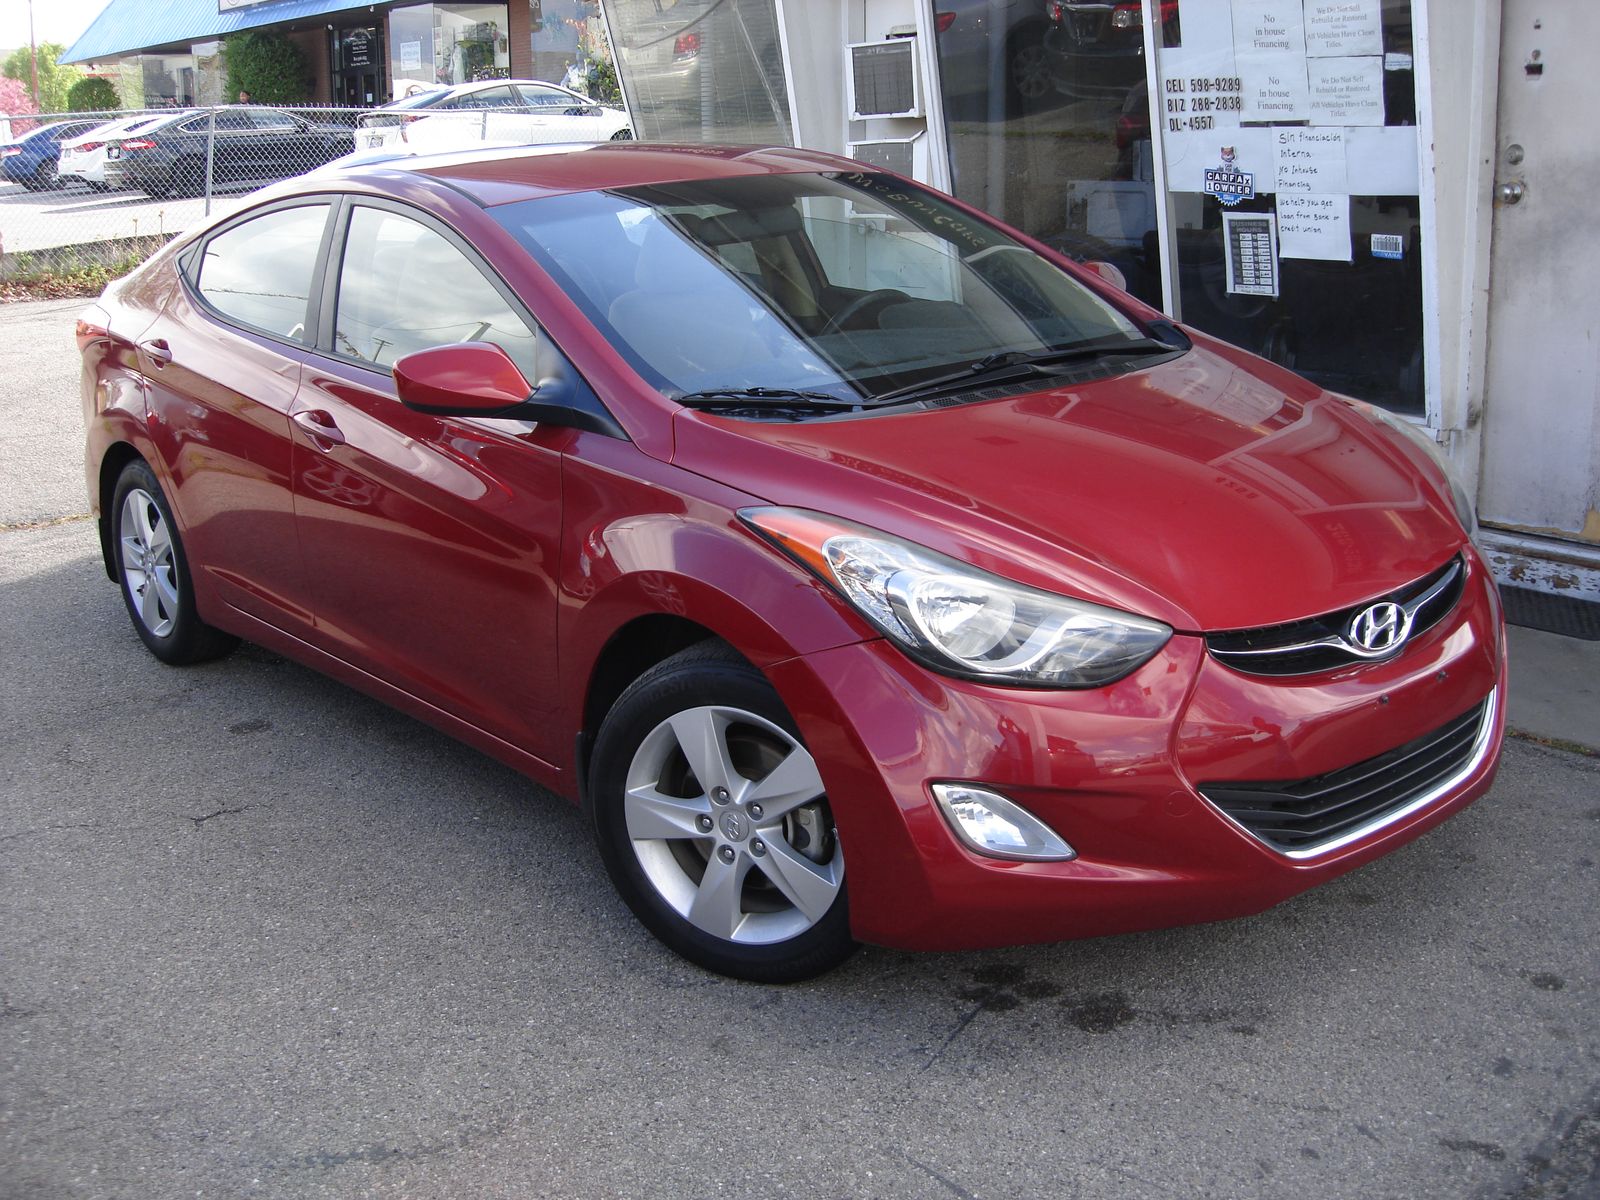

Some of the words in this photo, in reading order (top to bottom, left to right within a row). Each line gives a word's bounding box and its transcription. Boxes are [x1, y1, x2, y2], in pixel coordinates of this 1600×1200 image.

[1263, 14, 1275, 24] No
[1264, 27, 1286, 36] house
[1253, 39, 1290, 50] Financing
[1166, 79, 1184, 92] CEL
[1190, 77, 1241, 92] 598-9289
[1268, 76, 1280, 86] No
[1268, 88, 1290, 98] house
[1167, 98, 1186, 112] BIZ
[1191, 96, 1241, 112] 288-2838
[1257, 101, 1294, 112] Financing
[1279, 131, 1295, 144] Sin
[1206, 172, 1251, 185] CARFAX
[1214, 183, 1250, 195] OWNER
